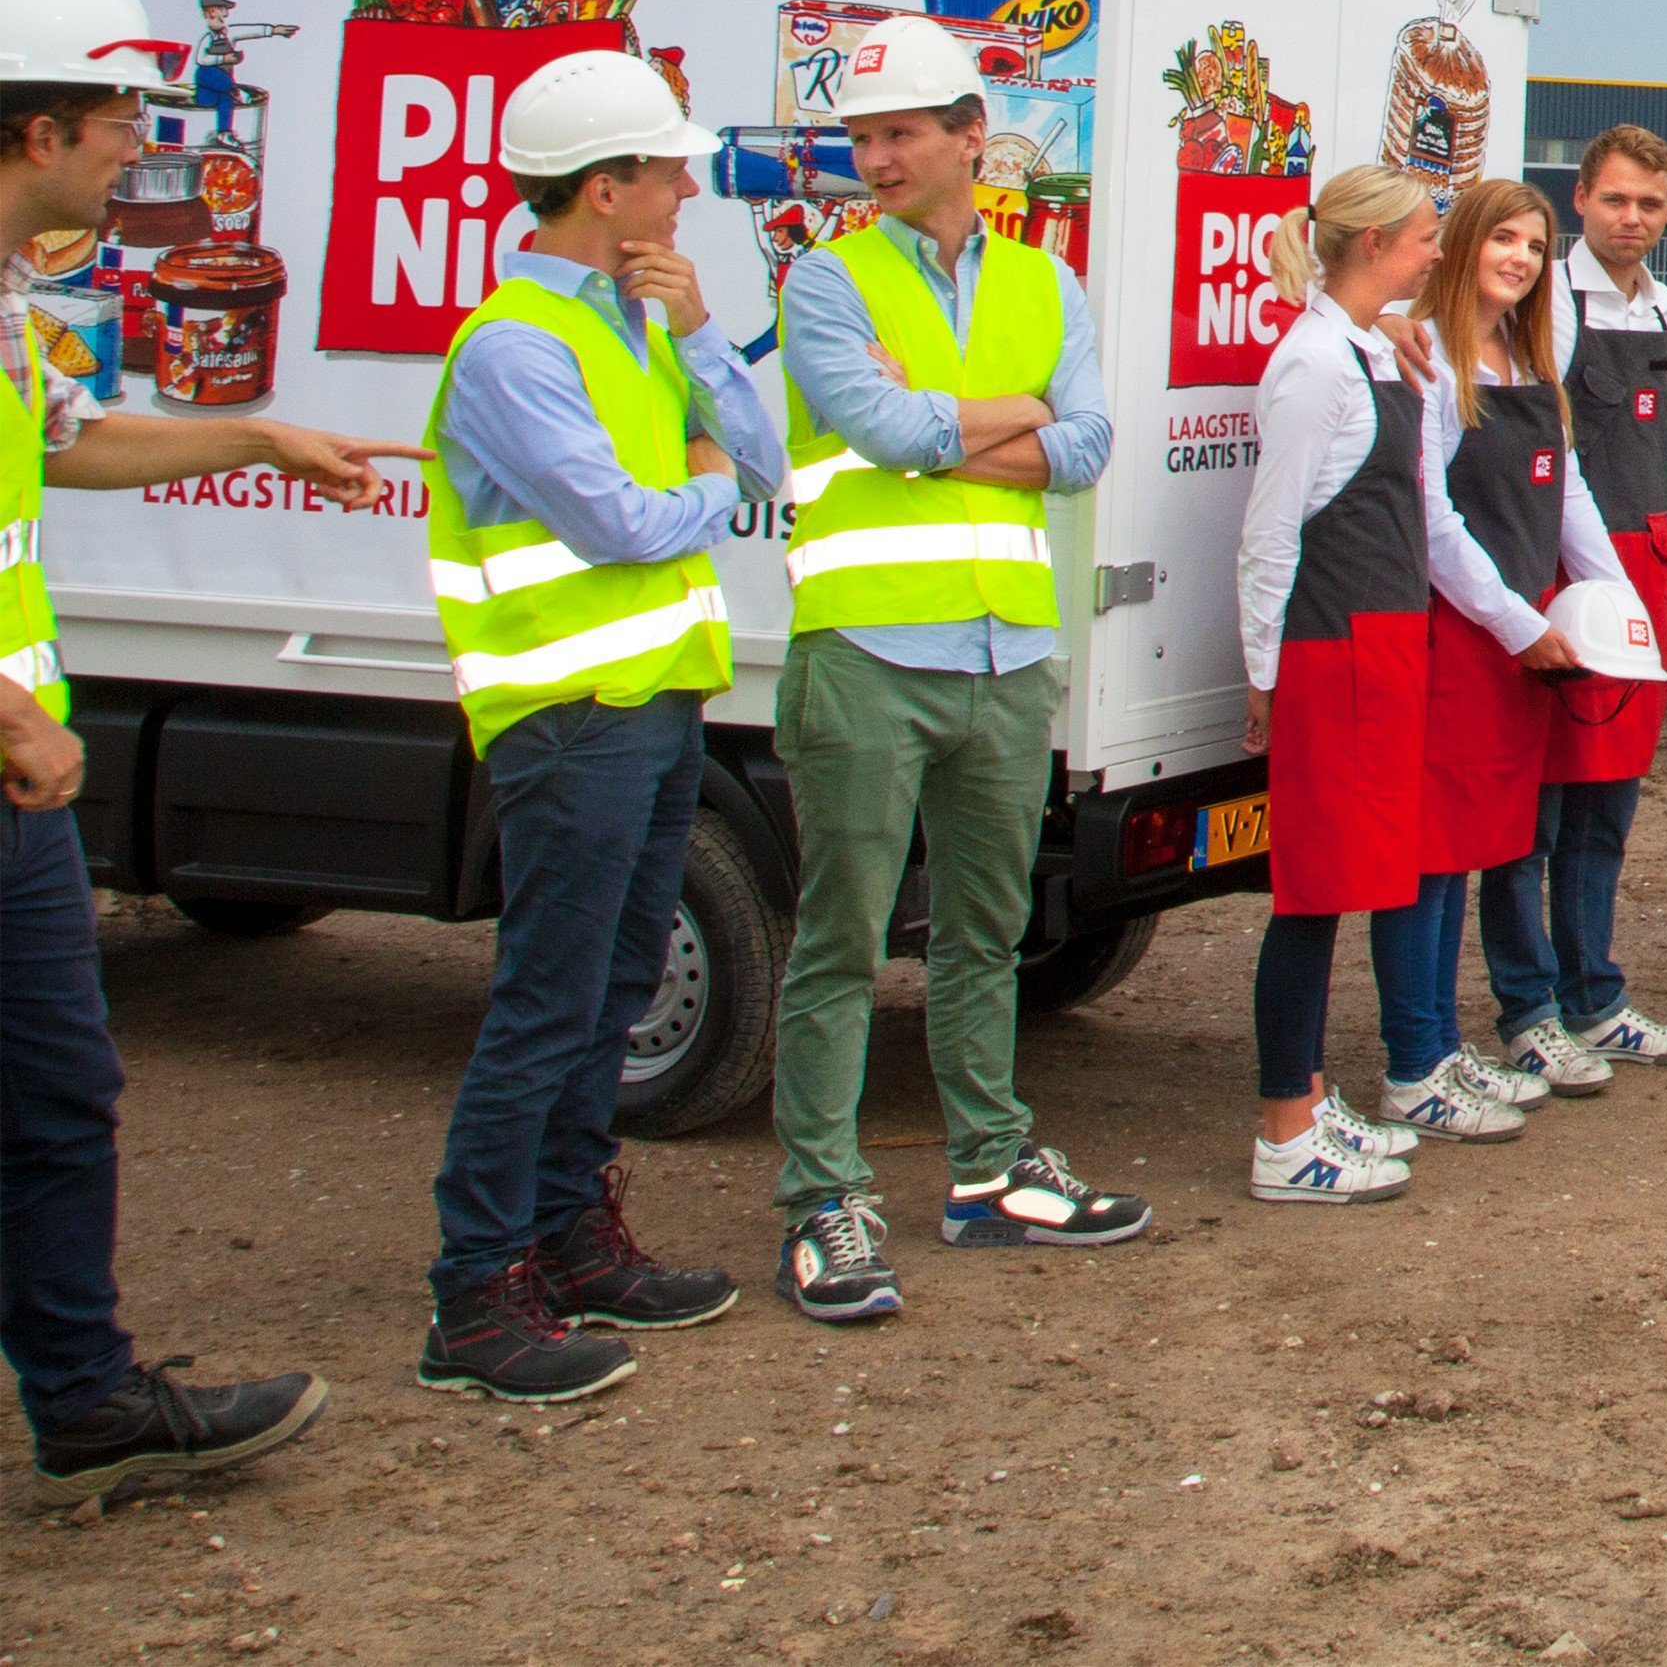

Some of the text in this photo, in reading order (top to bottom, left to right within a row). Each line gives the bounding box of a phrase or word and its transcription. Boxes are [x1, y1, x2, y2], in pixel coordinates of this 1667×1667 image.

[378, 74, 495, 182] PI
[1168, 412, 1250, 441] LAAGSTE
[1167, 442, 1237, 473] GRATIS
[143, 470, 324, 513] LAAGSTE
